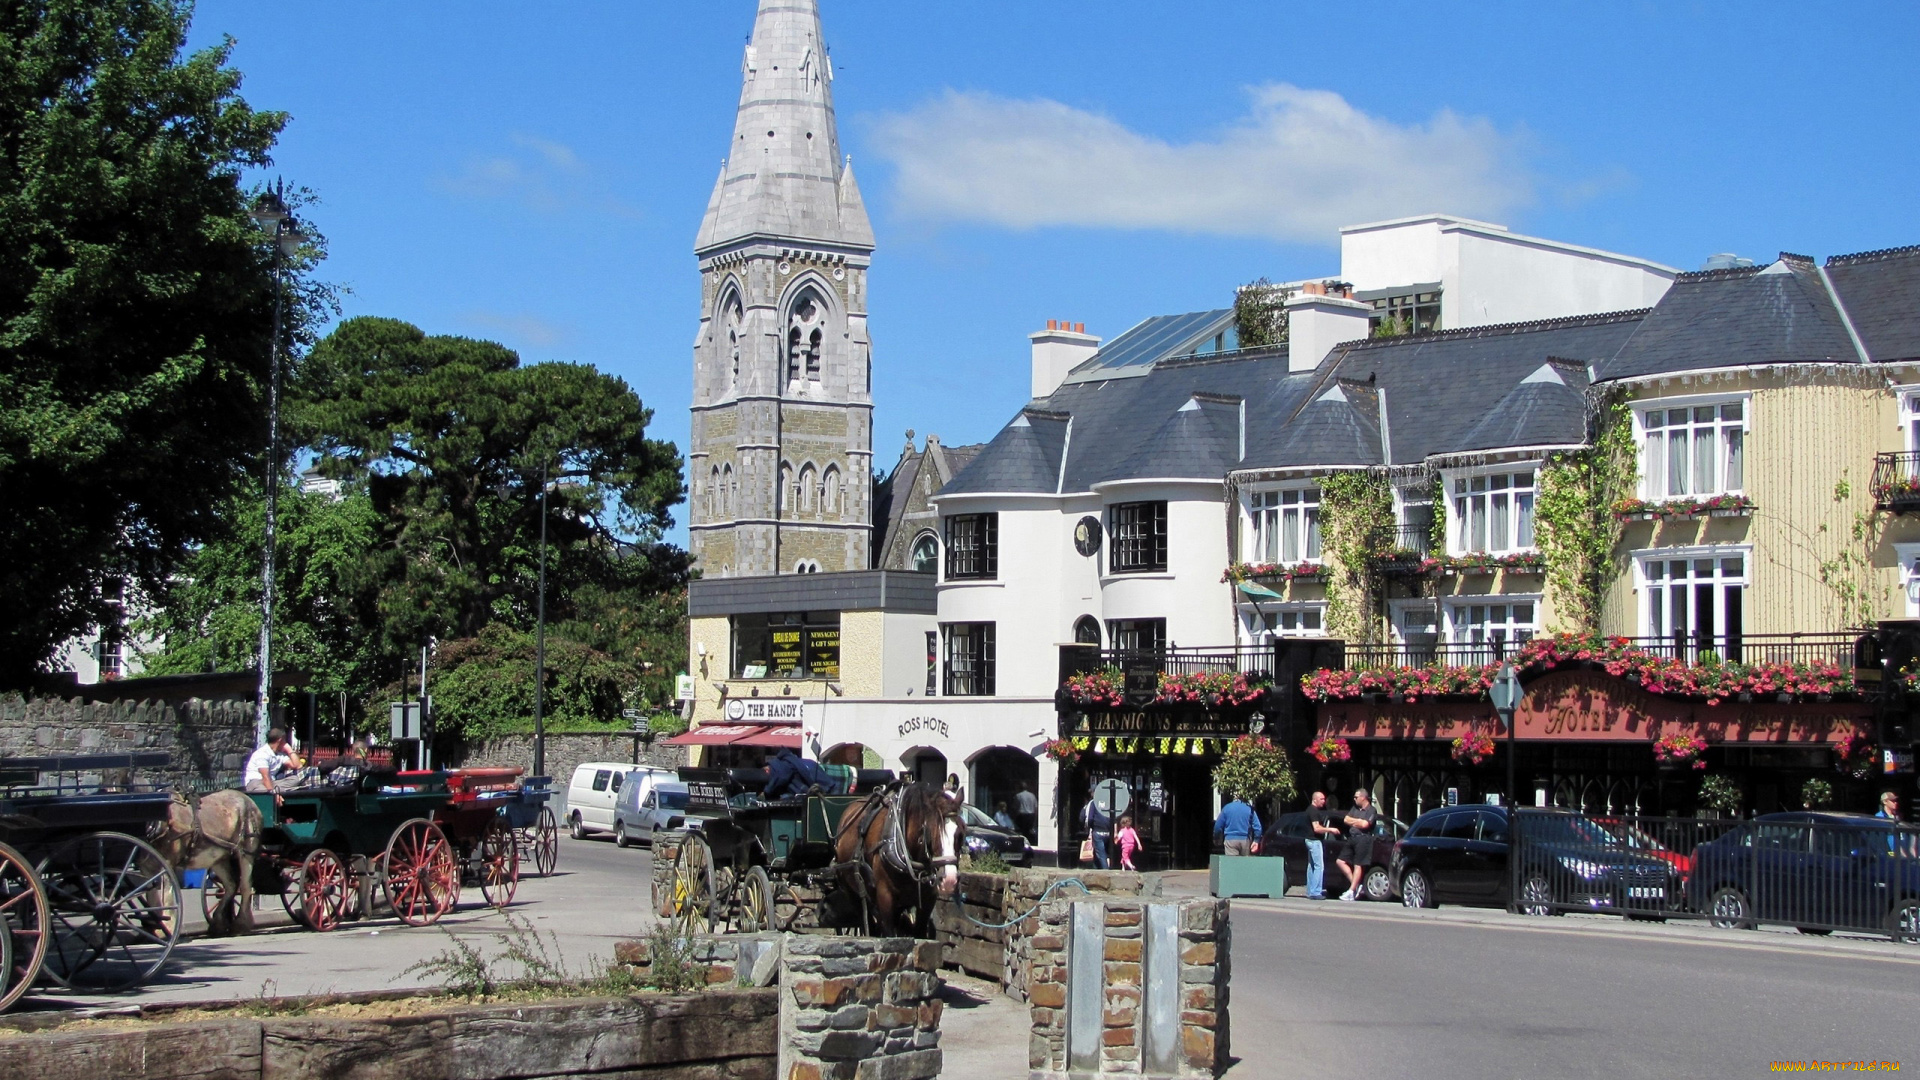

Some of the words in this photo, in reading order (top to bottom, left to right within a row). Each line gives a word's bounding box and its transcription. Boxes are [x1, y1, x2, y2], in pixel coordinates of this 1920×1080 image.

[748, 703, 765, 717] THE
[767, 704, 797, 718] HANDY
[898, 716, 921, 738] ROSS
[923, 716, 949, 738] HOTEL
[1094, 712, 1171, 730] HANNIGANS
[1176, 722, 1246, 731] RESTAURANT
[1544, 705, 1611, 734] HOTEL
[1884, 750, 1915, 766] Budget
